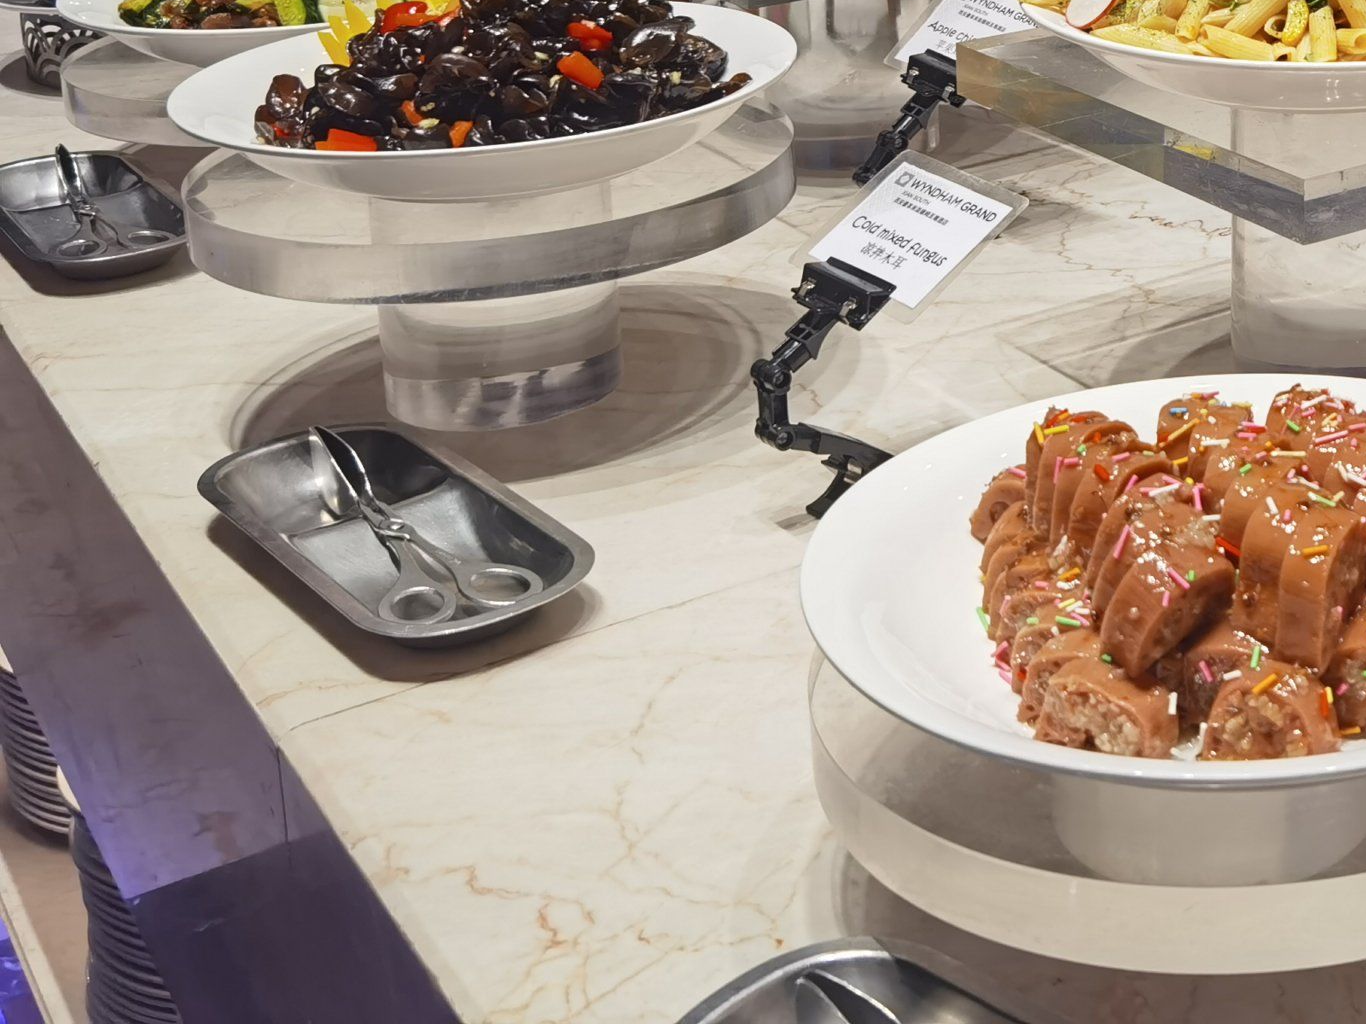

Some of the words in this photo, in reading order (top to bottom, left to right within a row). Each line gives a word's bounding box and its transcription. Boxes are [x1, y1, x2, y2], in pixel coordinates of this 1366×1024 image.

[928, 20, 957, 37] Apple
[910, 178, 964, 207] WYNDHAM
[960, 201, 997, 222] GRAND
[852, 215, 883, 234] Cold
[876, 228, 913, 248] mixed
[906, 242, 948, 266] fungus
